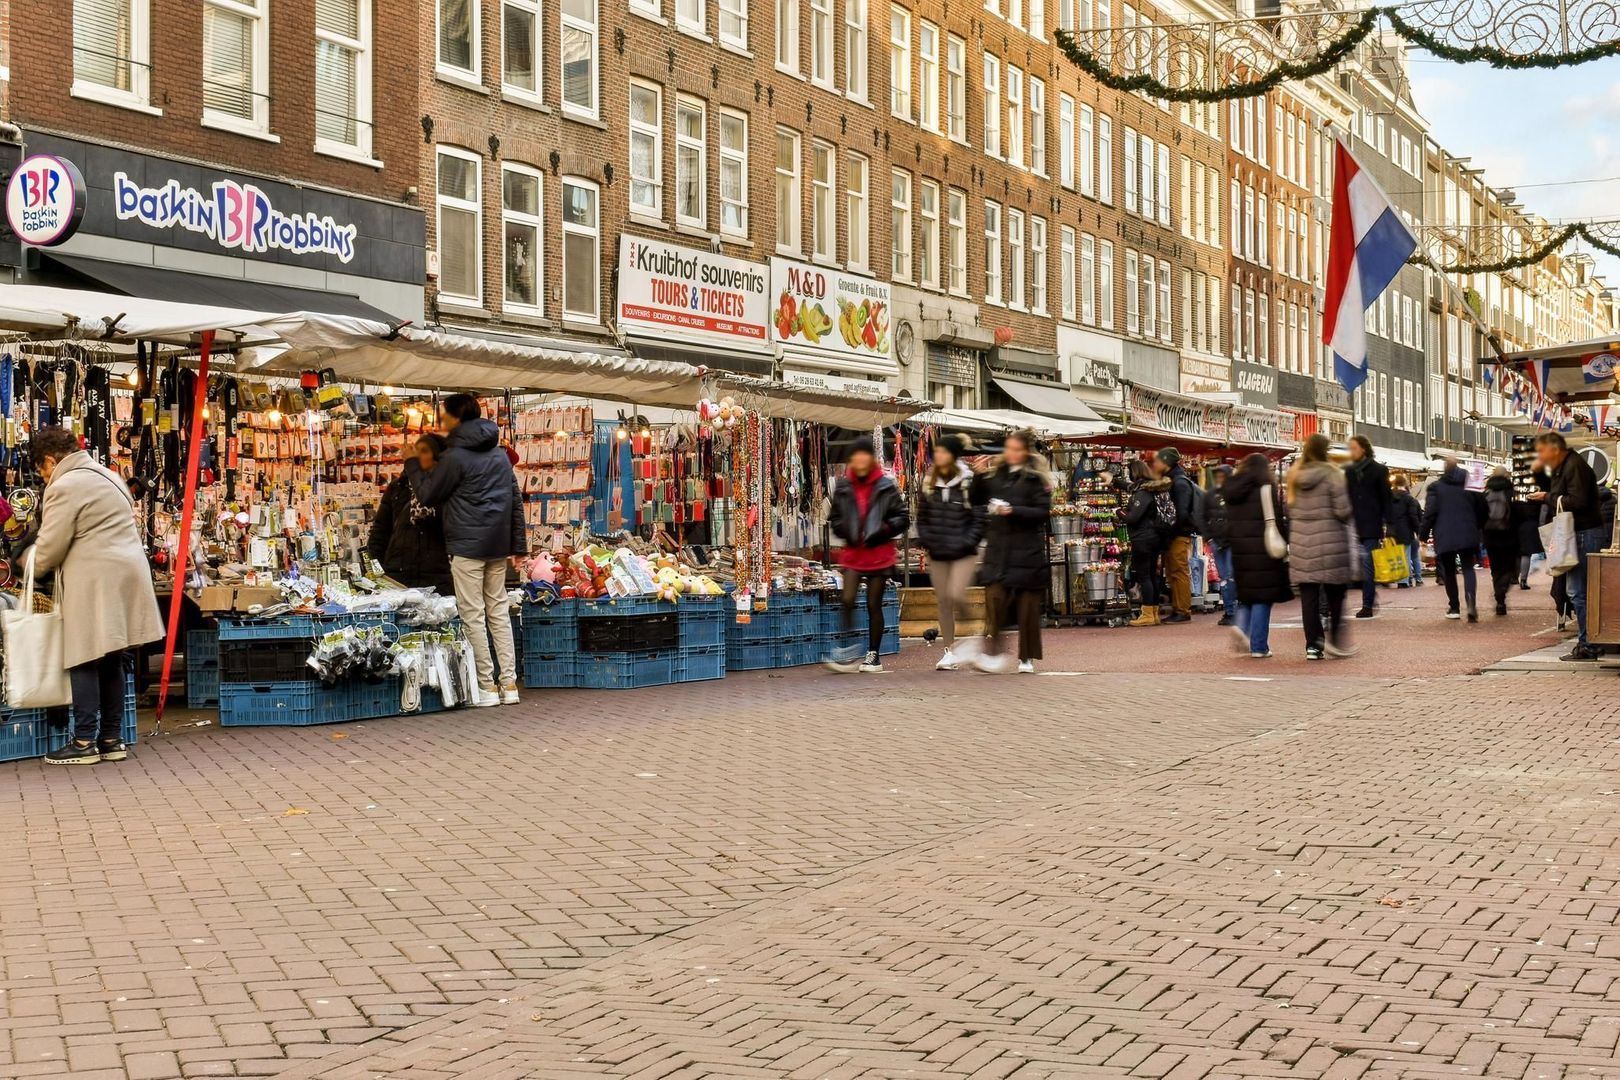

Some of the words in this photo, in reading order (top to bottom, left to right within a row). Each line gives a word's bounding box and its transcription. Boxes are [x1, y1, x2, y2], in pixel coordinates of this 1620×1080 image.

[20, 169, 60, 208] BR
[22, 206, 58, 220] baskin
[22, 218, 58, 231] robbins
[119, 178, 213, 233] baskin
[272, 213, 351, 257] robbins
[637, 243, 698, 280] Kruithof
[701, 263, 764, 294] souvenirs
[624, 306, 651, 318] SOUVENIRS
[651, 278, 689, 308] TOURS
[690, 286, 699, 310] &
[700, 287, 745, 318] TICKETS
[1237, 370, 1274, 395] SLAGERIJ
[1156, 401, 1202, 434] souvenirs
